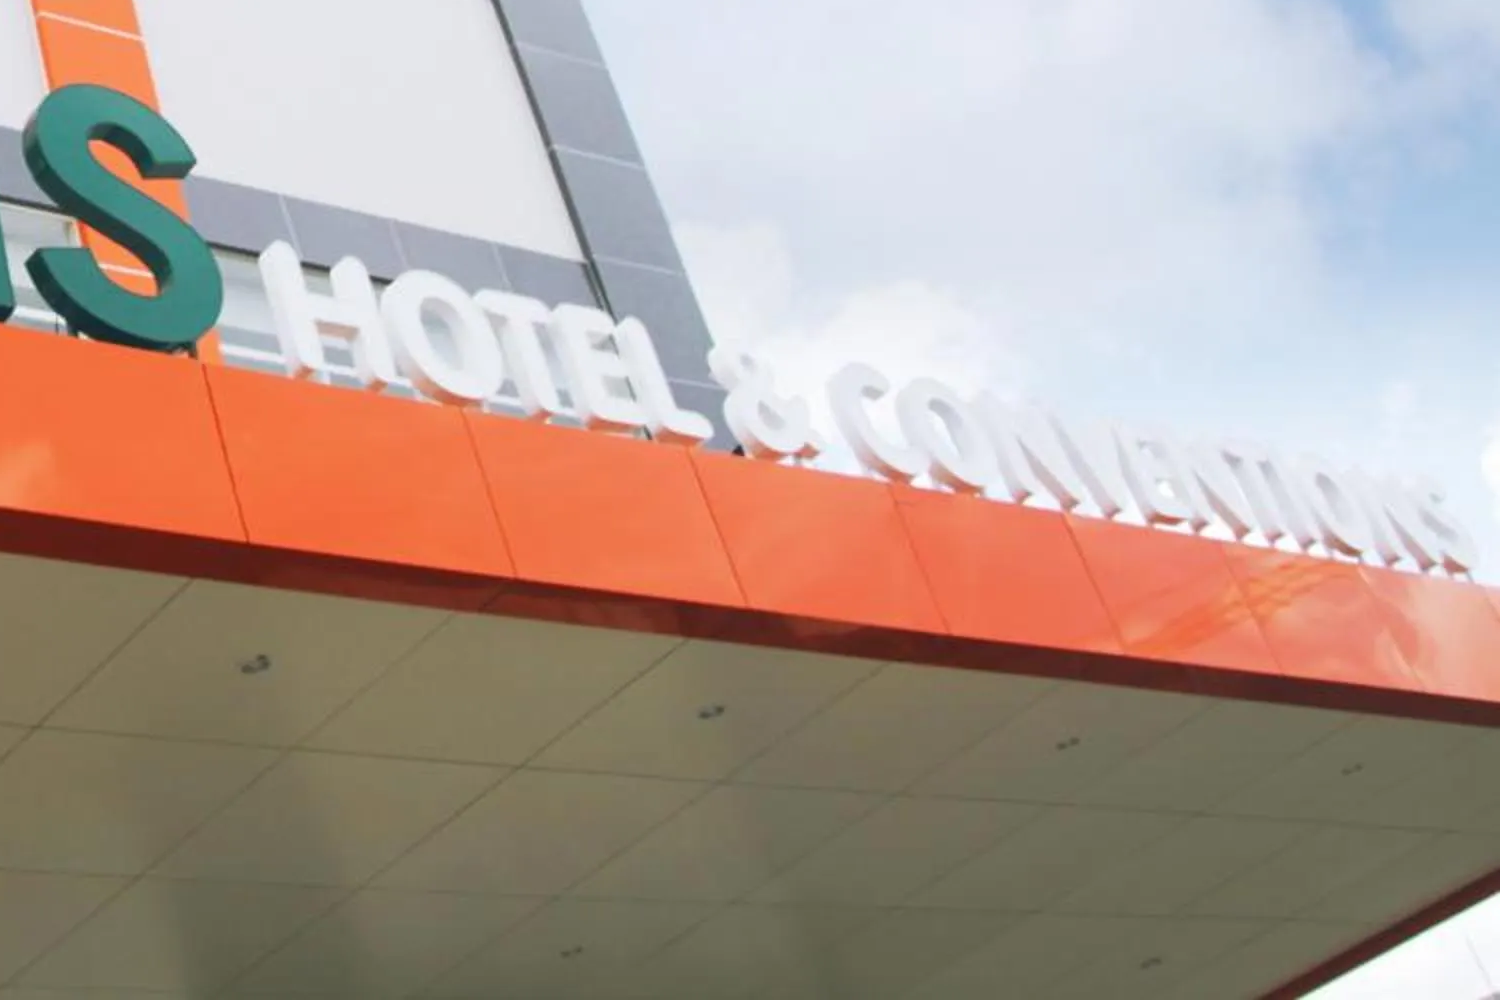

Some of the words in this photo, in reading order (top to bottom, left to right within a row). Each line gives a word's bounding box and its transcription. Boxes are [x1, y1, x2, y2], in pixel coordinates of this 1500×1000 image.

[258, 239, 714, 446] HOTEL
[707, 343, 820, 460] &
[826, 361, 1476, 575] CONVENTIONS
